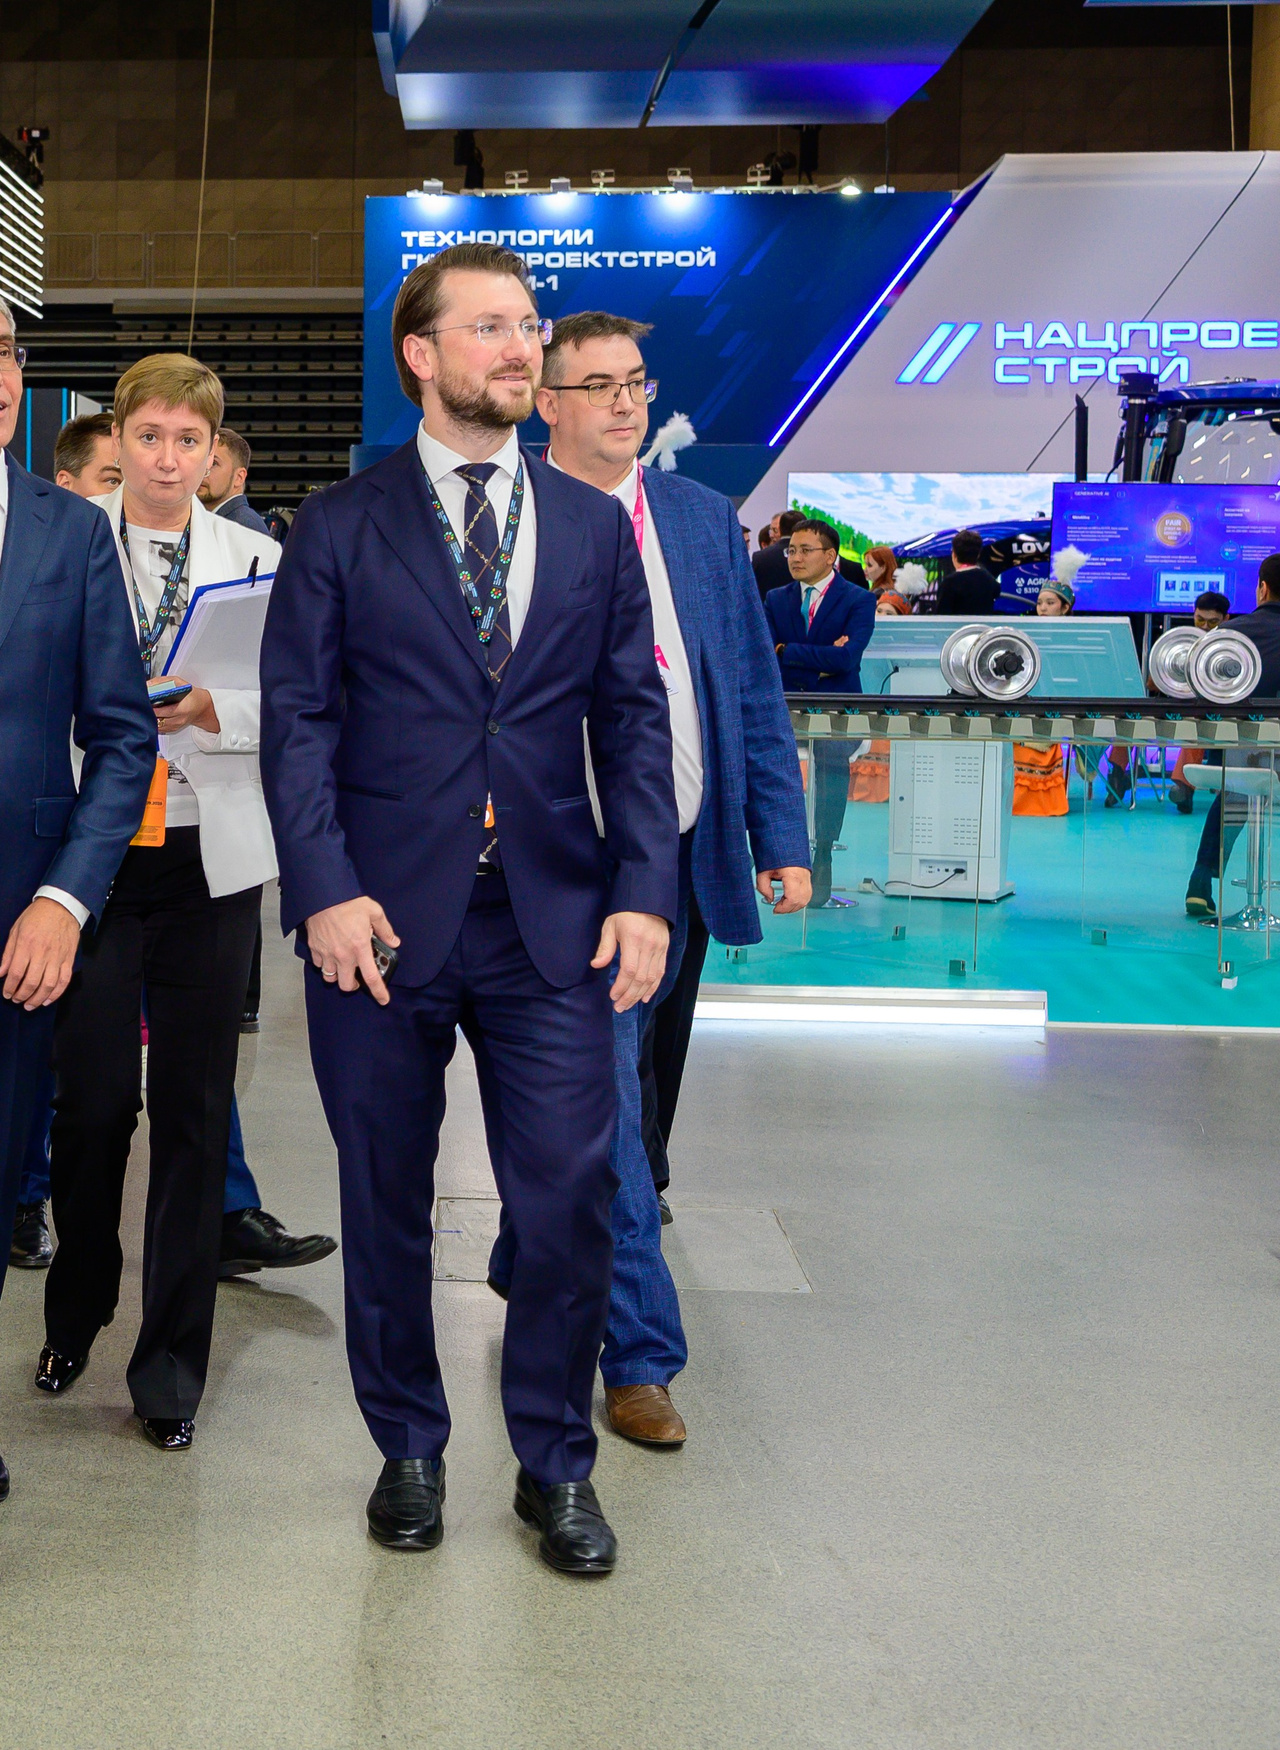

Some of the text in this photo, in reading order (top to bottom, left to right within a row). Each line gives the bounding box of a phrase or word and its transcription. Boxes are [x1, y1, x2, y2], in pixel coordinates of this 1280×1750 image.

[401, 229, 594, 248] ТЕХНОЛОГИИ
[994, 321, 1279, 353] НАЦПРОЕ
[994, 350, 1190, 384] СТРОЙ
